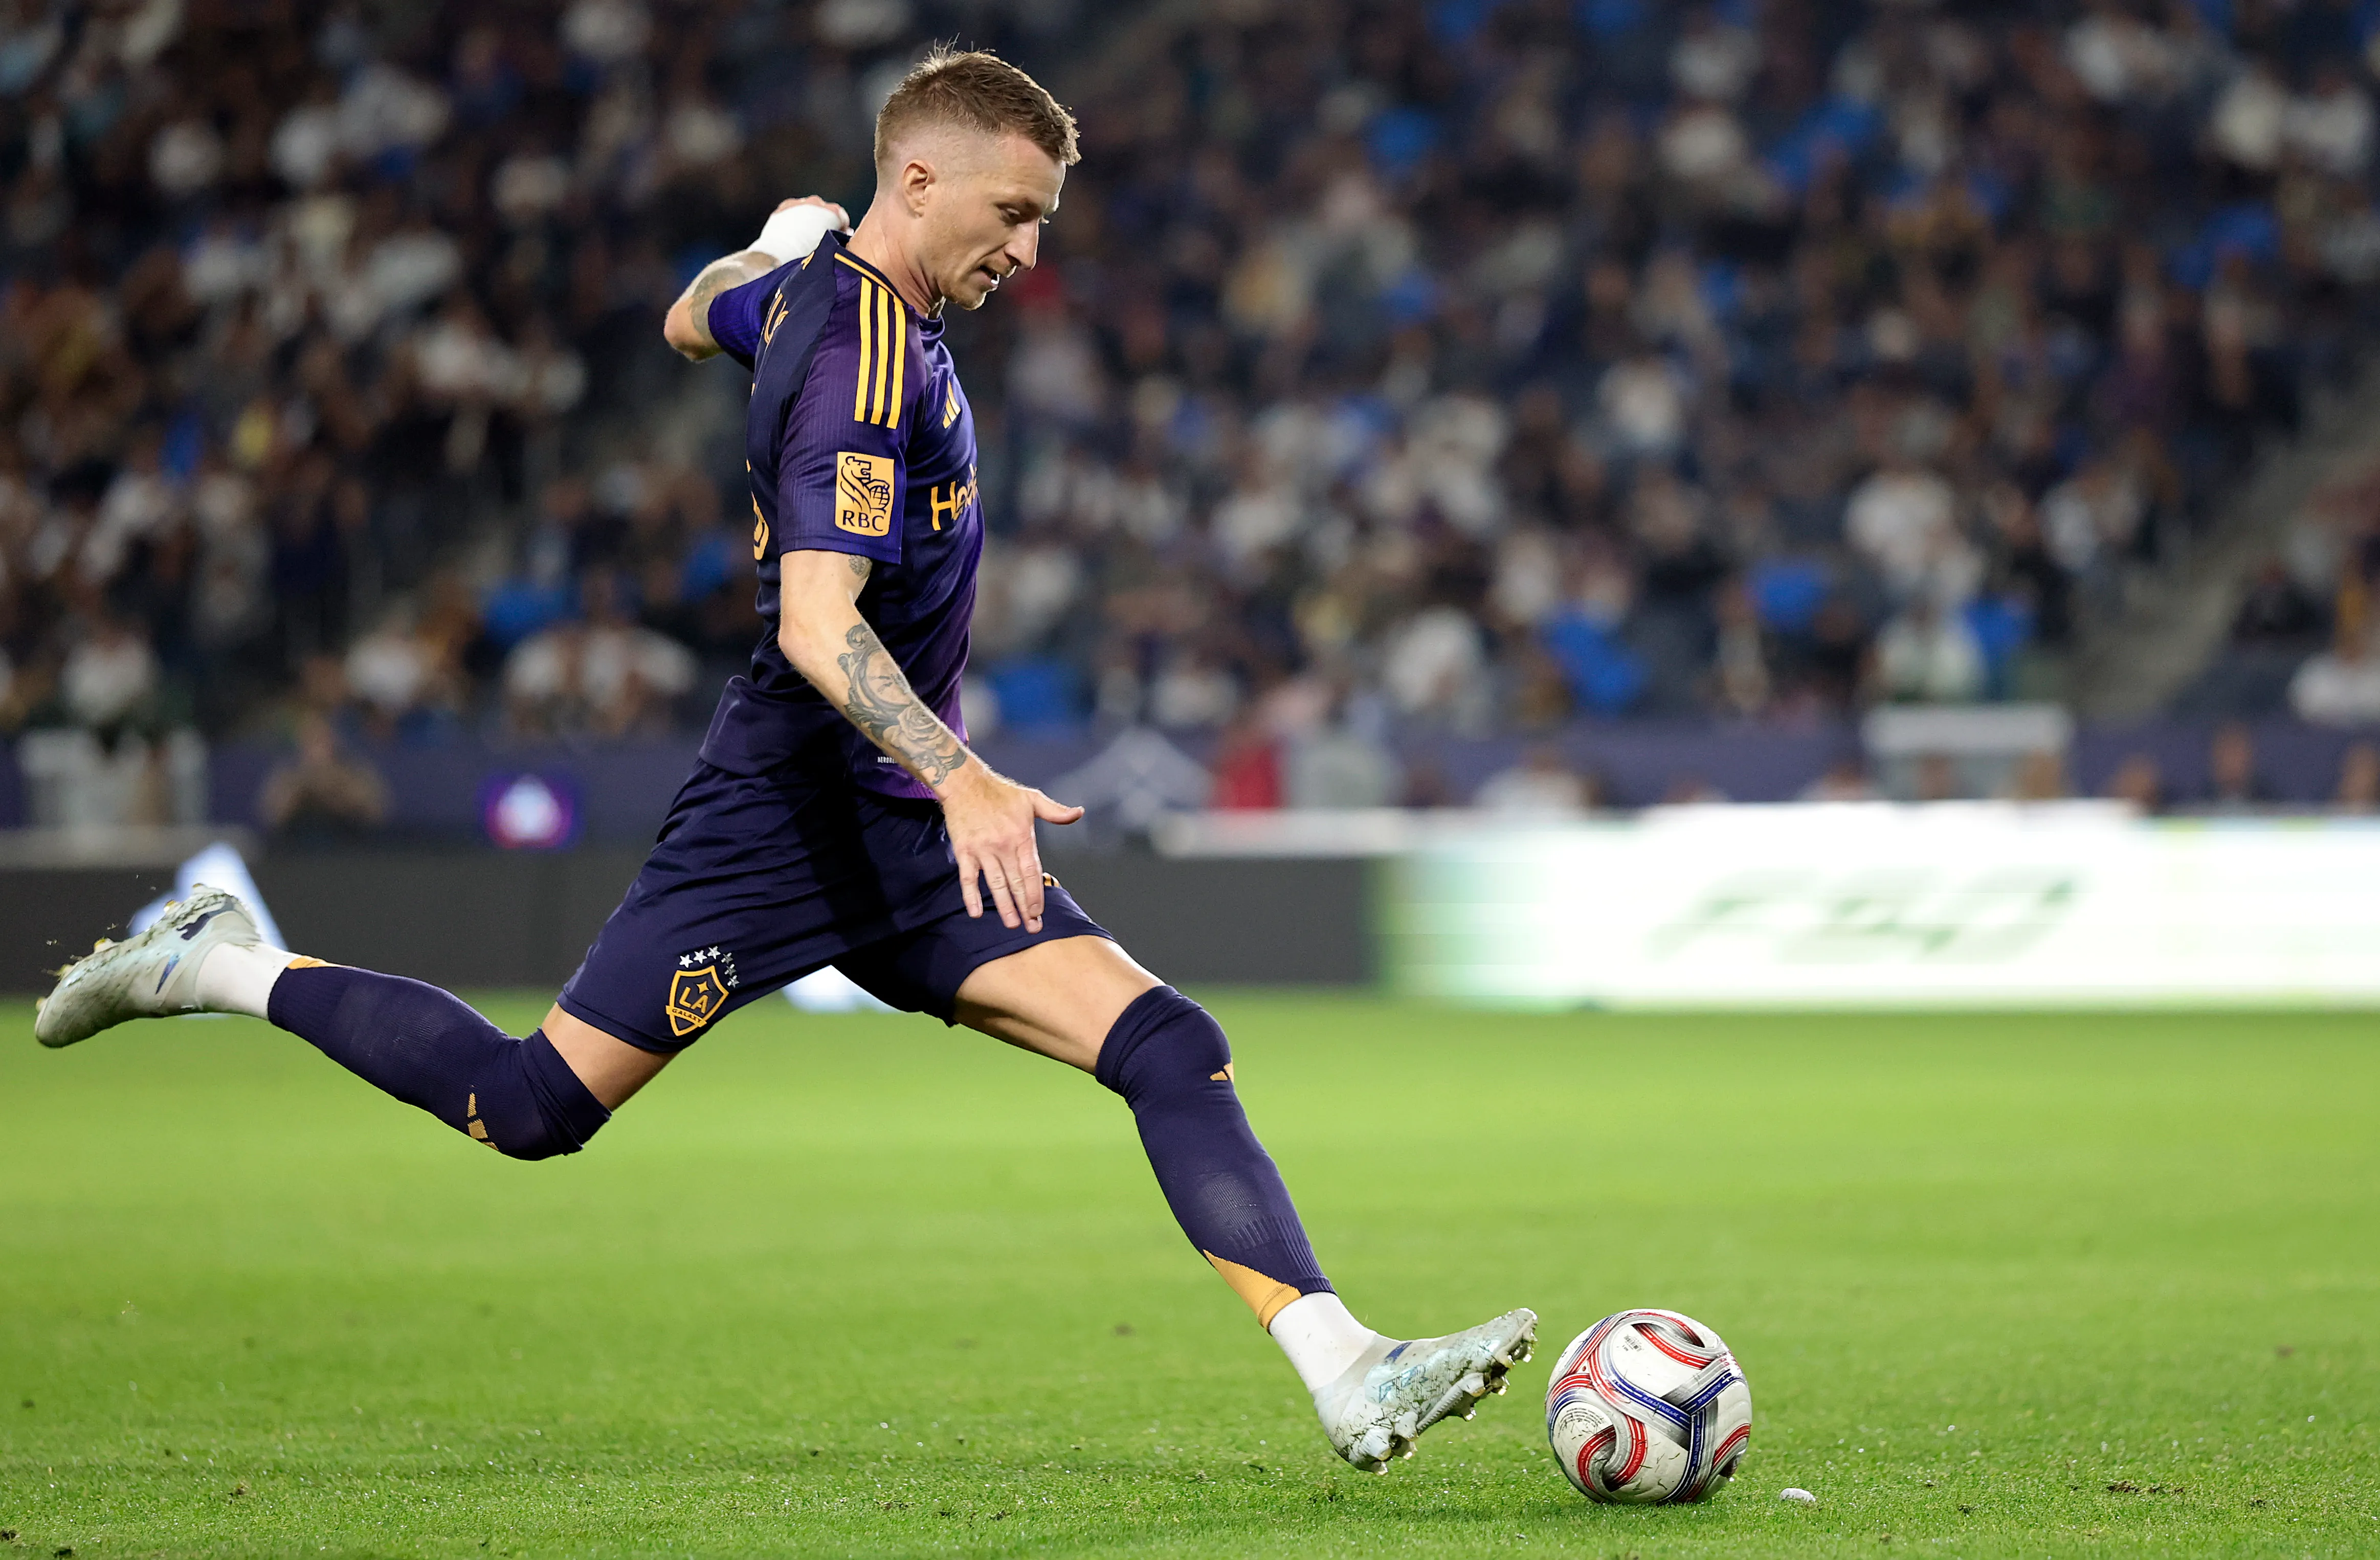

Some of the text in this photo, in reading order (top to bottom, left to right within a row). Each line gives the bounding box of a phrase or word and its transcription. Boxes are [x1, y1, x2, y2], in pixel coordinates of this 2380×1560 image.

[842, 509, 884, 532] RBC
[679, 986, 709, 1014] LA
[672, 1008, 702, 1023] GALAXY
